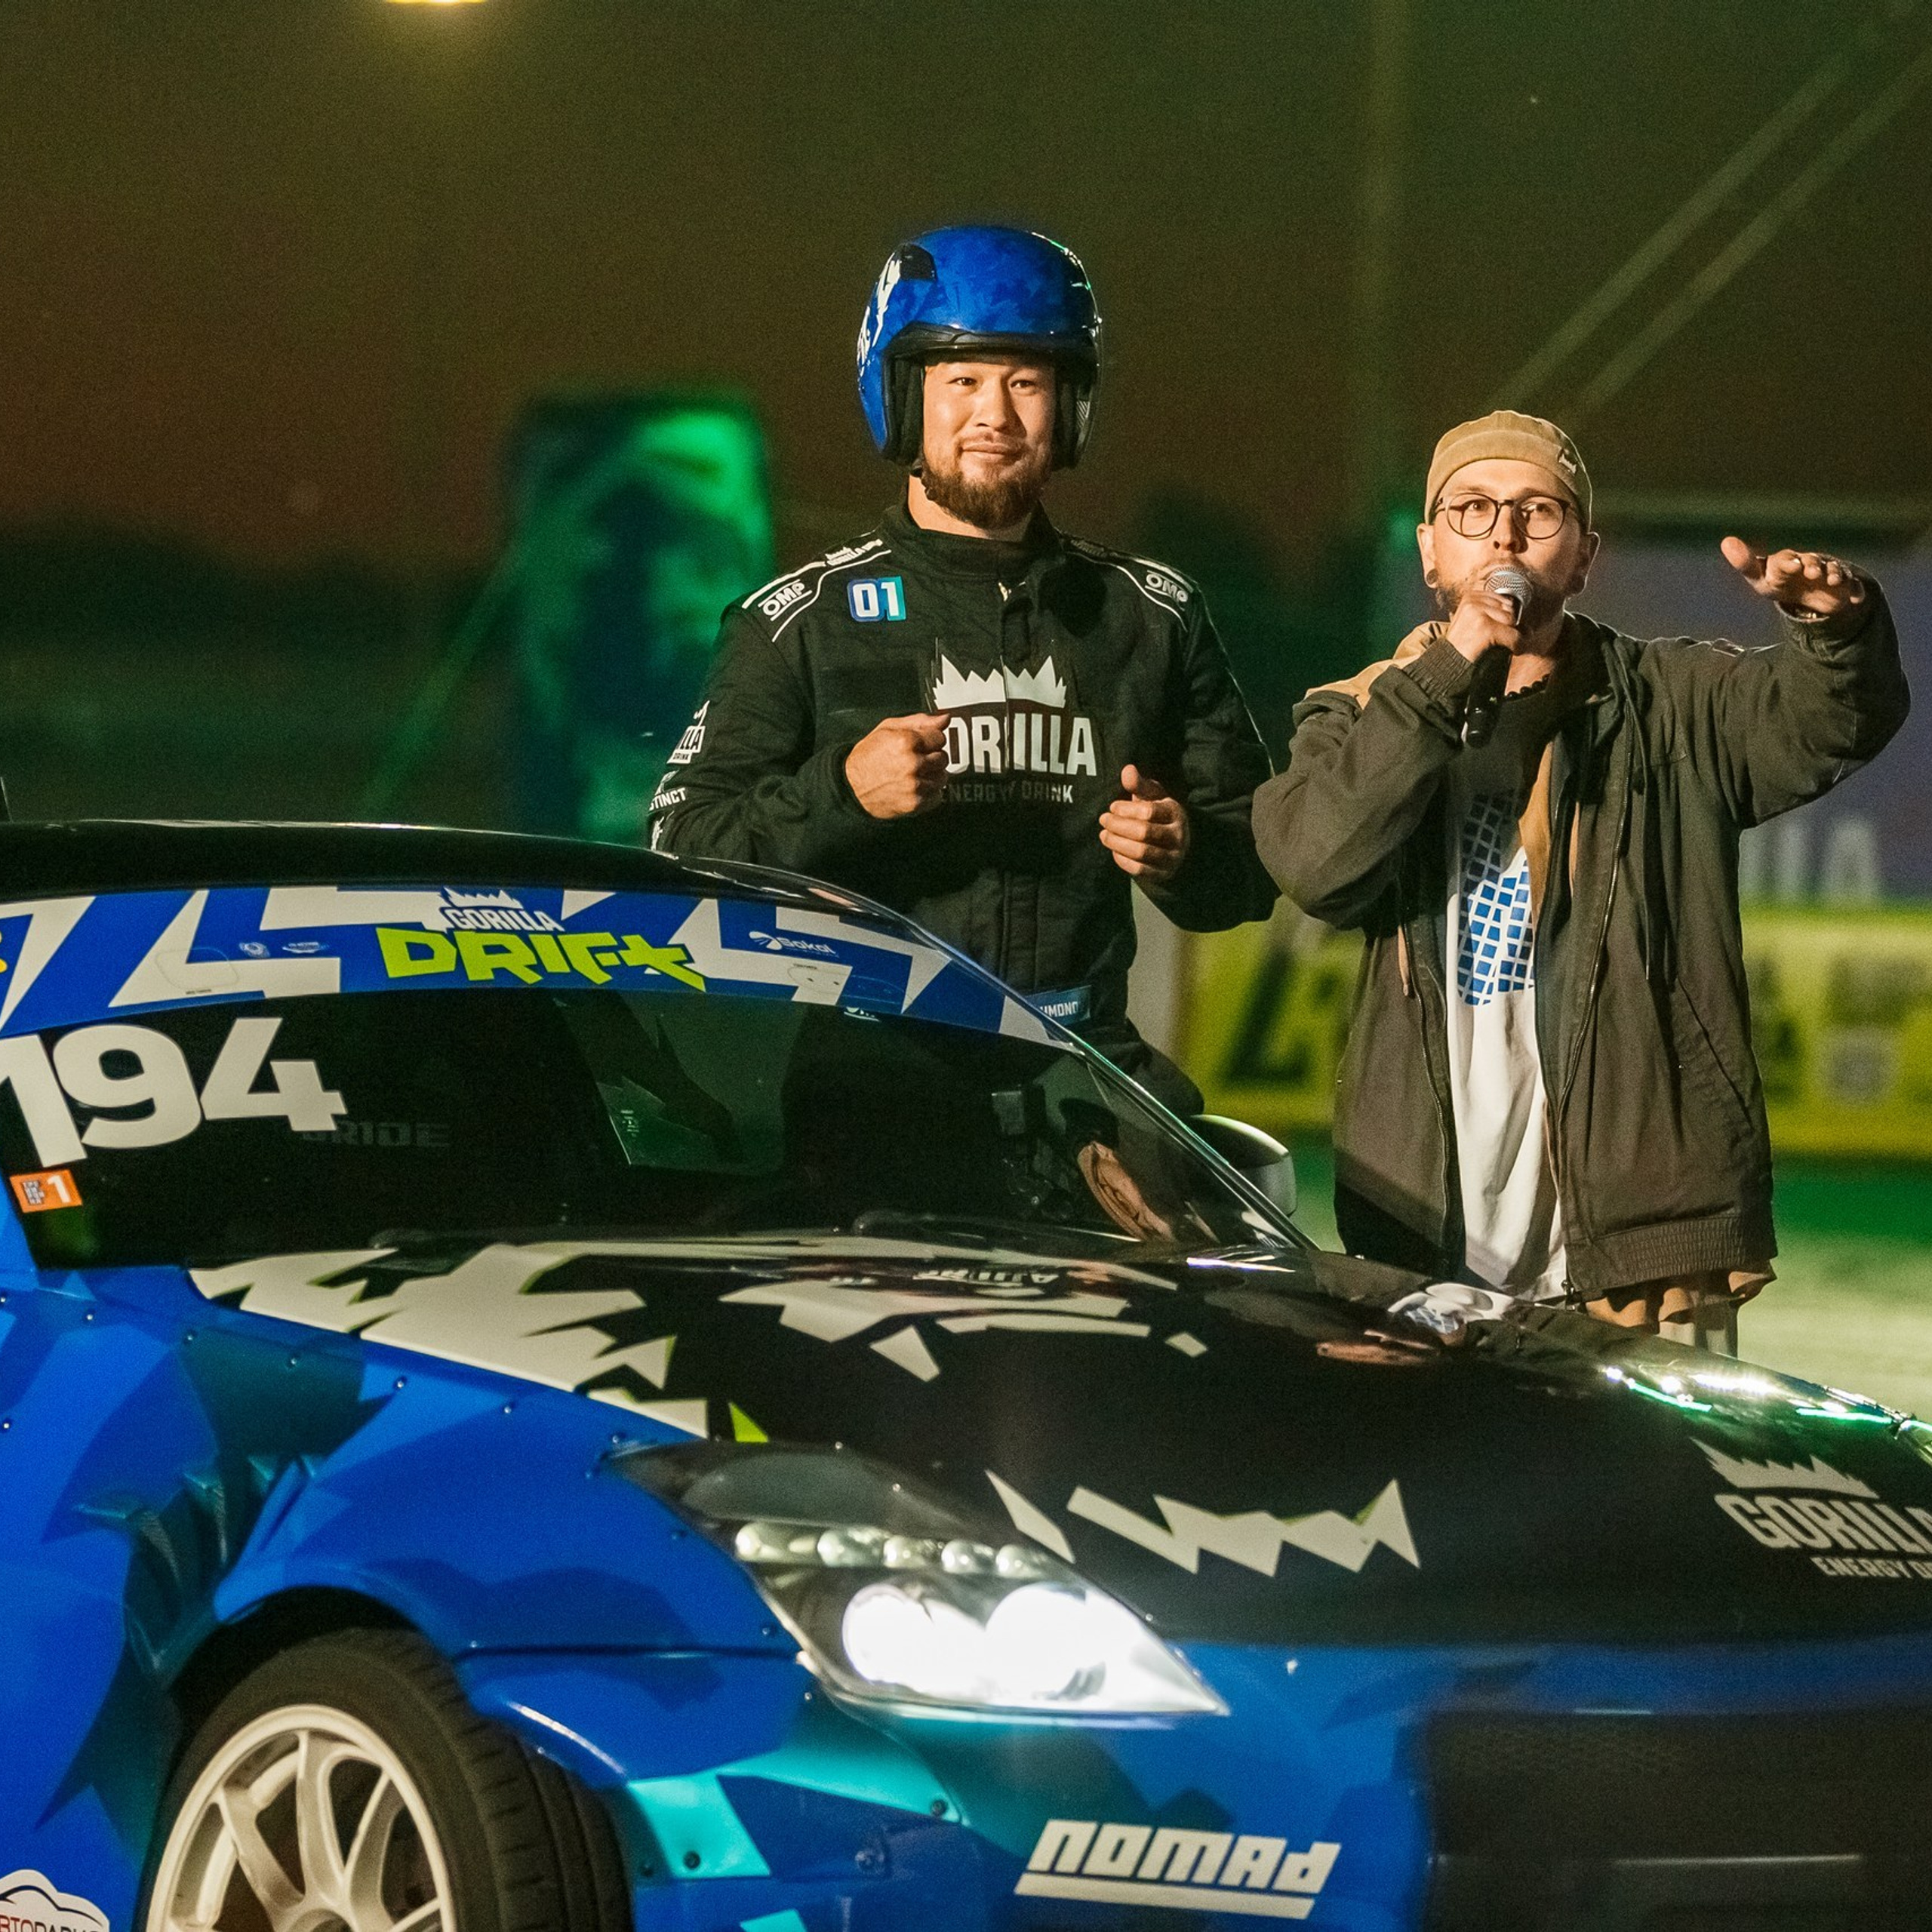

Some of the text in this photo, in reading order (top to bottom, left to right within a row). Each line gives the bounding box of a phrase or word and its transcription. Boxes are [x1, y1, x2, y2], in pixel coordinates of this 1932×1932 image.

[762, 583, 805, 616] OMP
[852, 582, 900, 618] 01
[1146, 574, 1188, 604] OMP
[941, 712, 1097, 777] ORILLA
[445, 909, 565, 932] GORILLA
[0, 1017, 348, 1168] 194
[47, 1175, 72, 1204] 1
